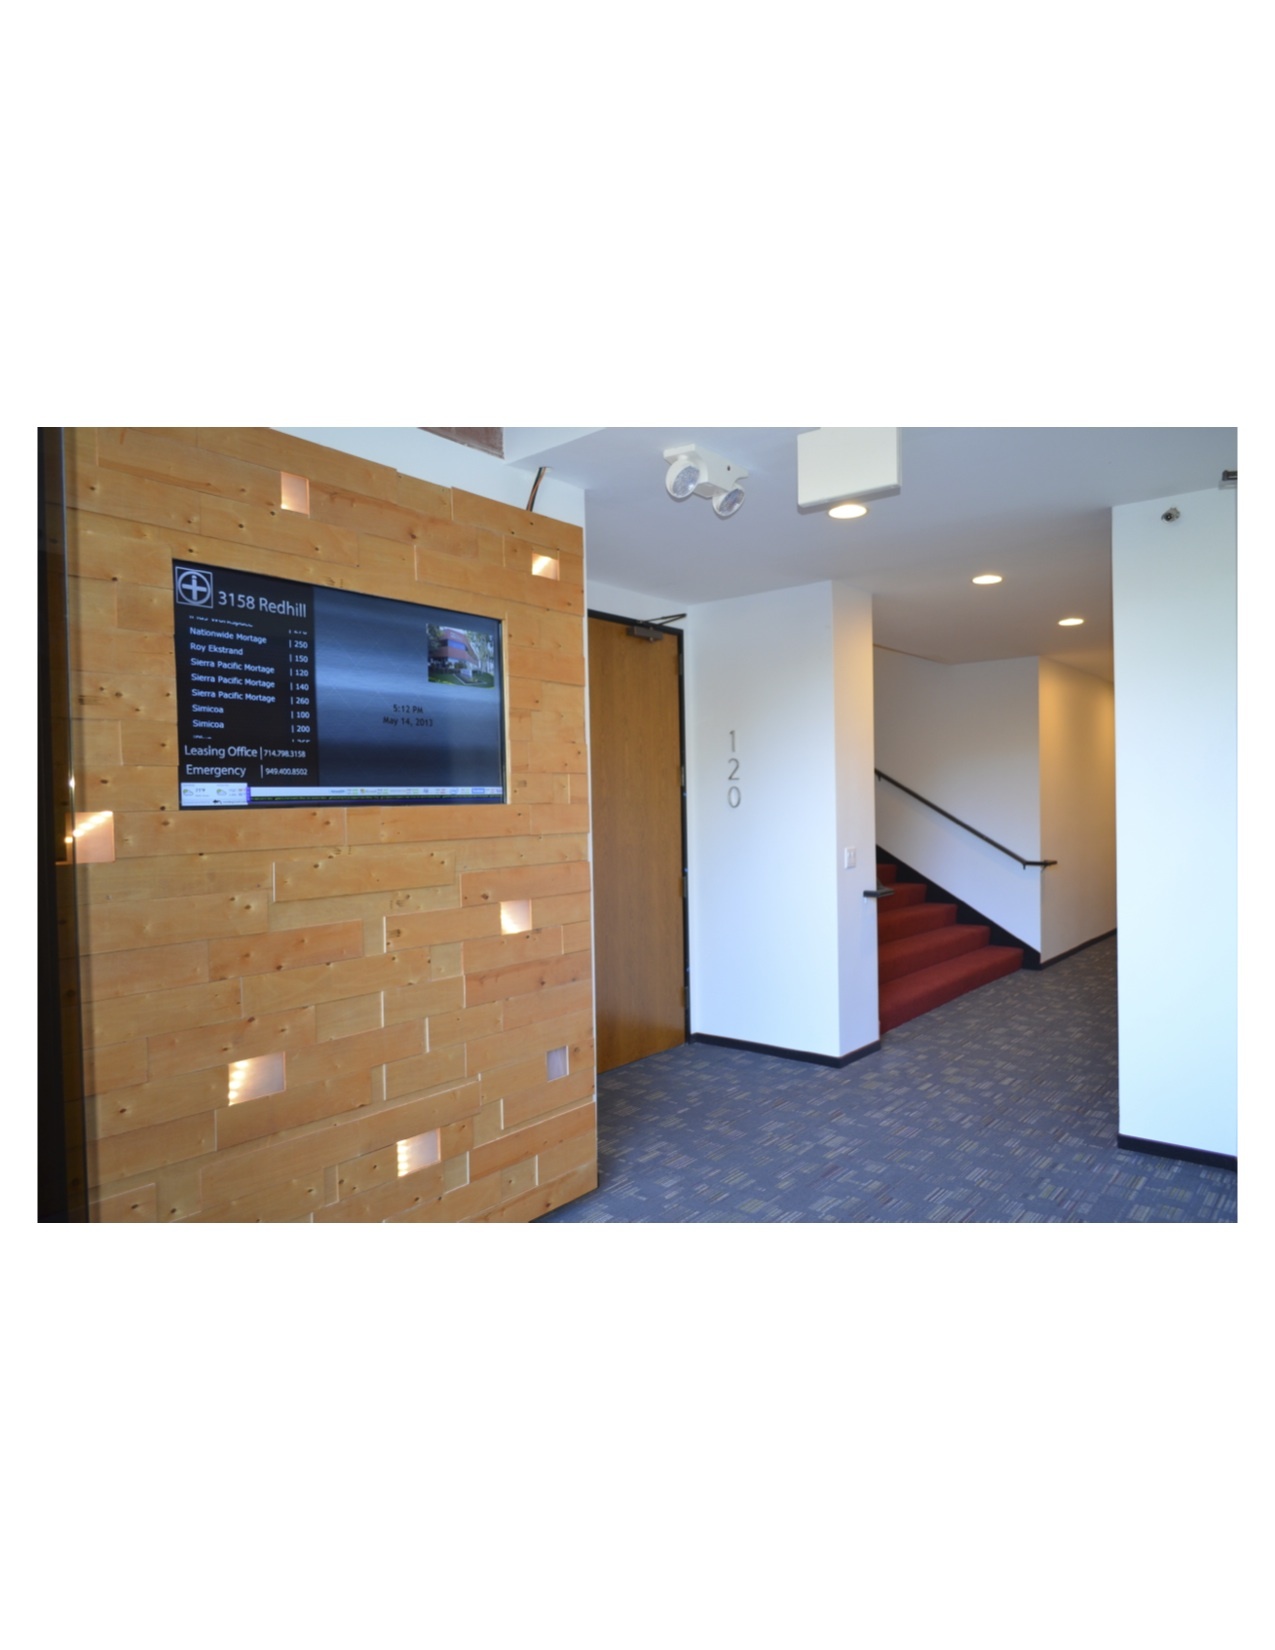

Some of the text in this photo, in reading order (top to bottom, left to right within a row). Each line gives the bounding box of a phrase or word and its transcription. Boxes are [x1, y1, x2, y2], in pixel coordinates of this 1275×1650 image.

[218, 590, 306, 618] 3158 Redhill
[190, 627, 308, 649] Nationwide Mortage 250
[190, 642, 308, 663] Roy Ekstrand 150
[190, 658, 309, 677] Sierra Pacific Mortage 120
[191, 673, 309, 691] Sierra Pacific Mortage 140
[191, 688, 309, 705] Sierra Pacific Mortage 260
[192, 704, 310, 719] Simicoa 100
[393, 704, 424, 714] 5:12 PM
[192, 719, 310, 733] Simicoa 200
[383, 716, 398, 726] May
[184, 744, 306, 759] Leasing Office 714.798.3158
[186, 764, 308, 778] Emergency 949.400.8502
